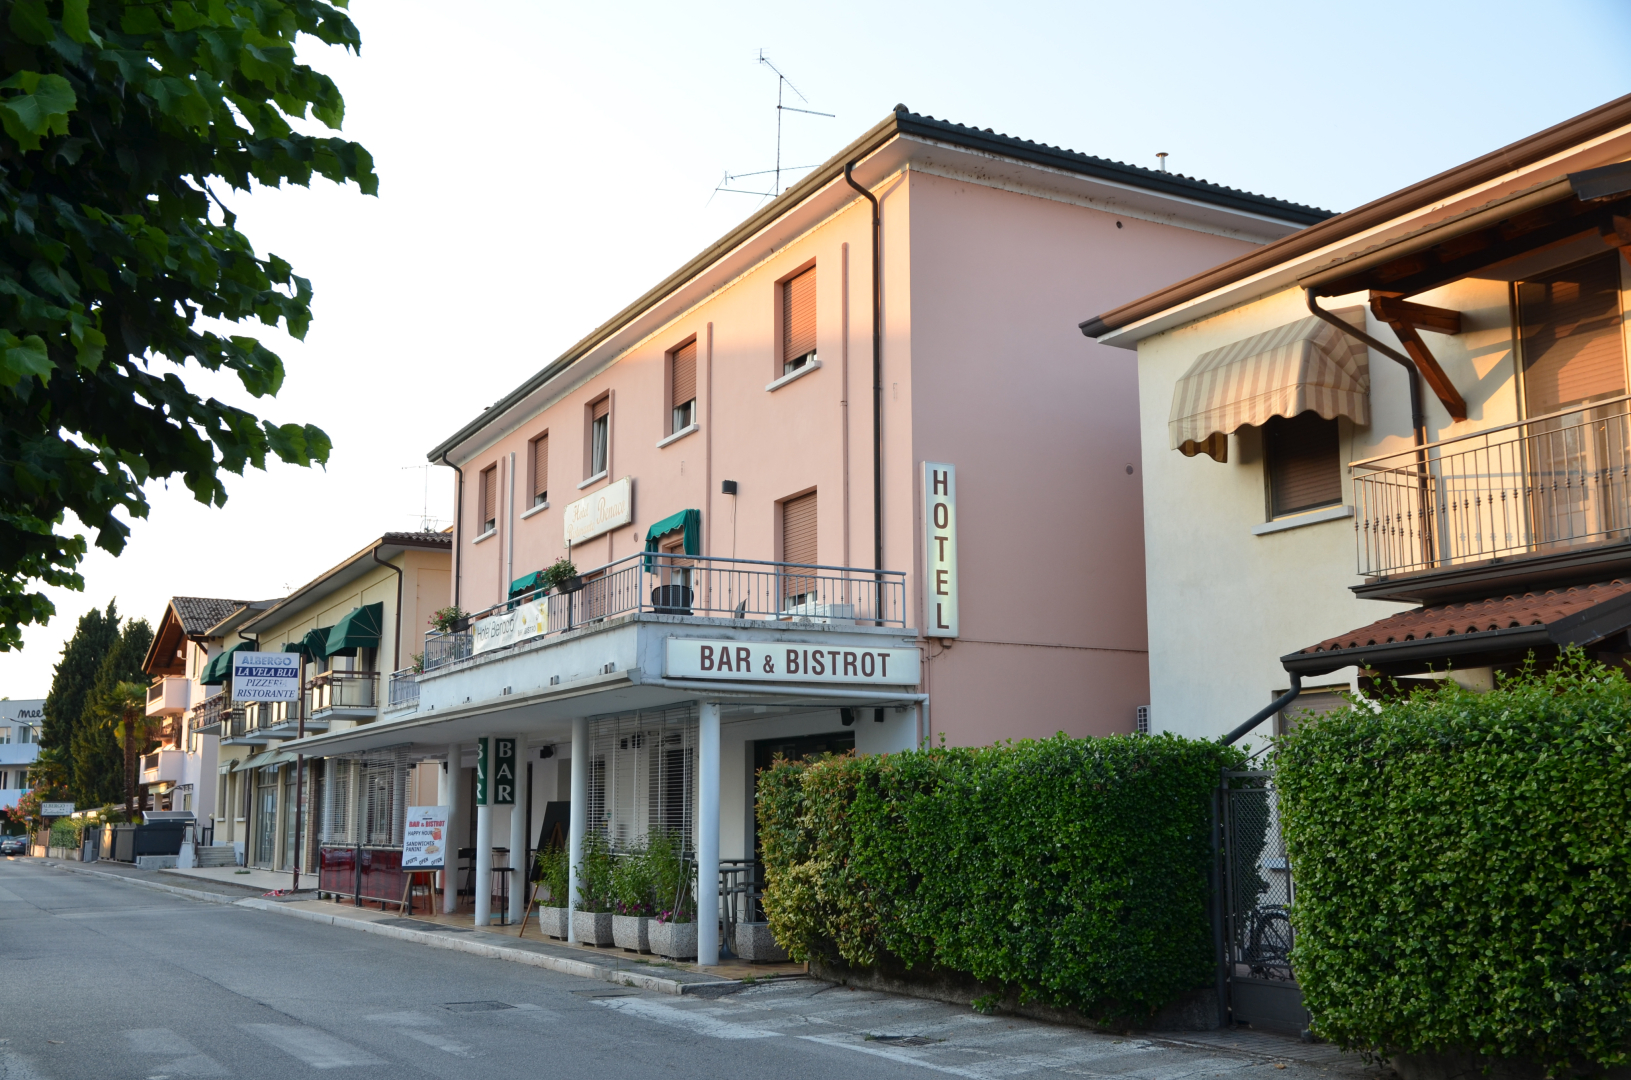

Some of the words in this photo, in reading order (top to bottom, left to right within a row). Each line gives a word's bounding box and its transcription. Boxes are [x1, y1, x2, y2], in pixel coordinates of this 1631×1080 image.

[572, 503, 589, 523] Hotel
[596, 497, 626, 525] Benaco
[933, 470, 949, 630] HOTEL
[491, 618, 514, 638] Benaco
[241, 655, 292, 666] ALBERGO
[700, 645, 751, 672] BAR
[763, 655, 775, 674] &
[786, 649, 890, 677] BISTROT
[237, 667, 250, 676] LA
[252, 667, 275, 677] VELA
[276, 668, 296, 677] BLU
[237, 689, 295, 698] RISTORANTE
[496, 741, 513, 801] BAR
[425, 820, 446, 828] BISTROT
[419, 857, 429, 866] OPEN
